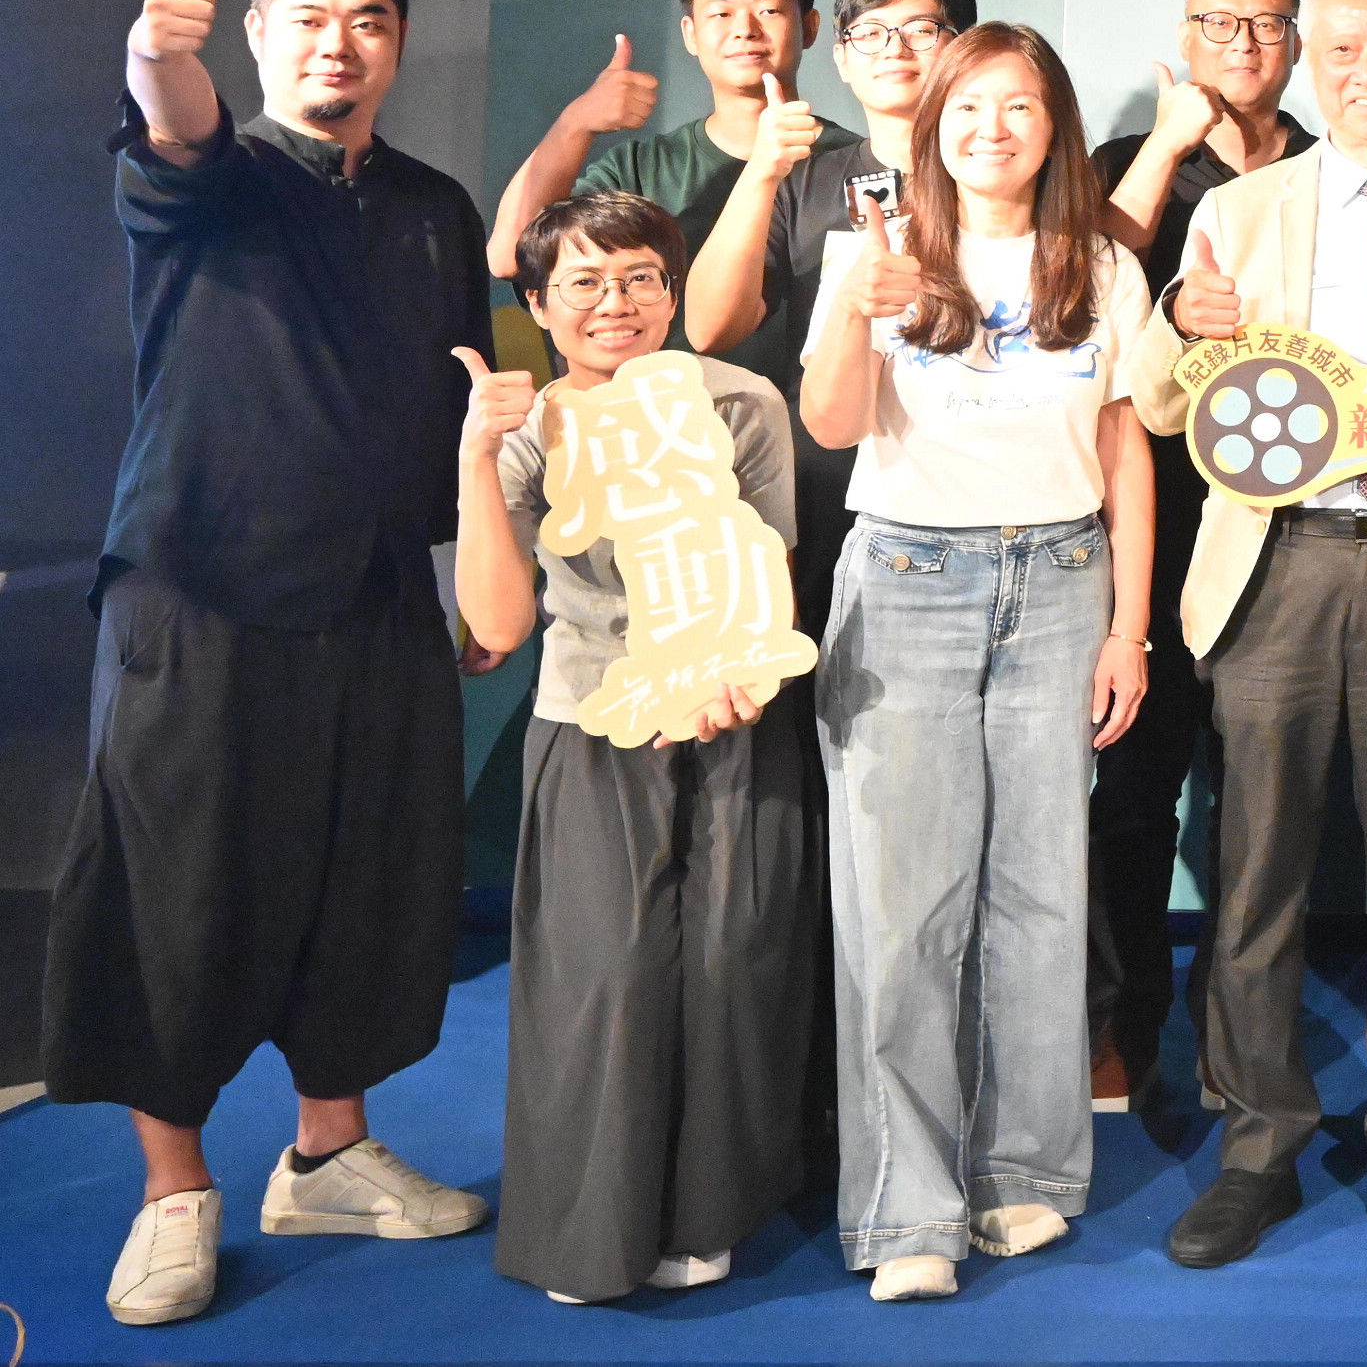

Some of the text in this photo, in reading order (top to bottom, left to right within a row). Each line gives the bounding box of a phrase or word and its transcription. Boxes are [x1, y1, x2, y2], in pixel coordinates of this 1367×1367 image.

[1182, 329, 1356, 389] 紀錄片友善城市
